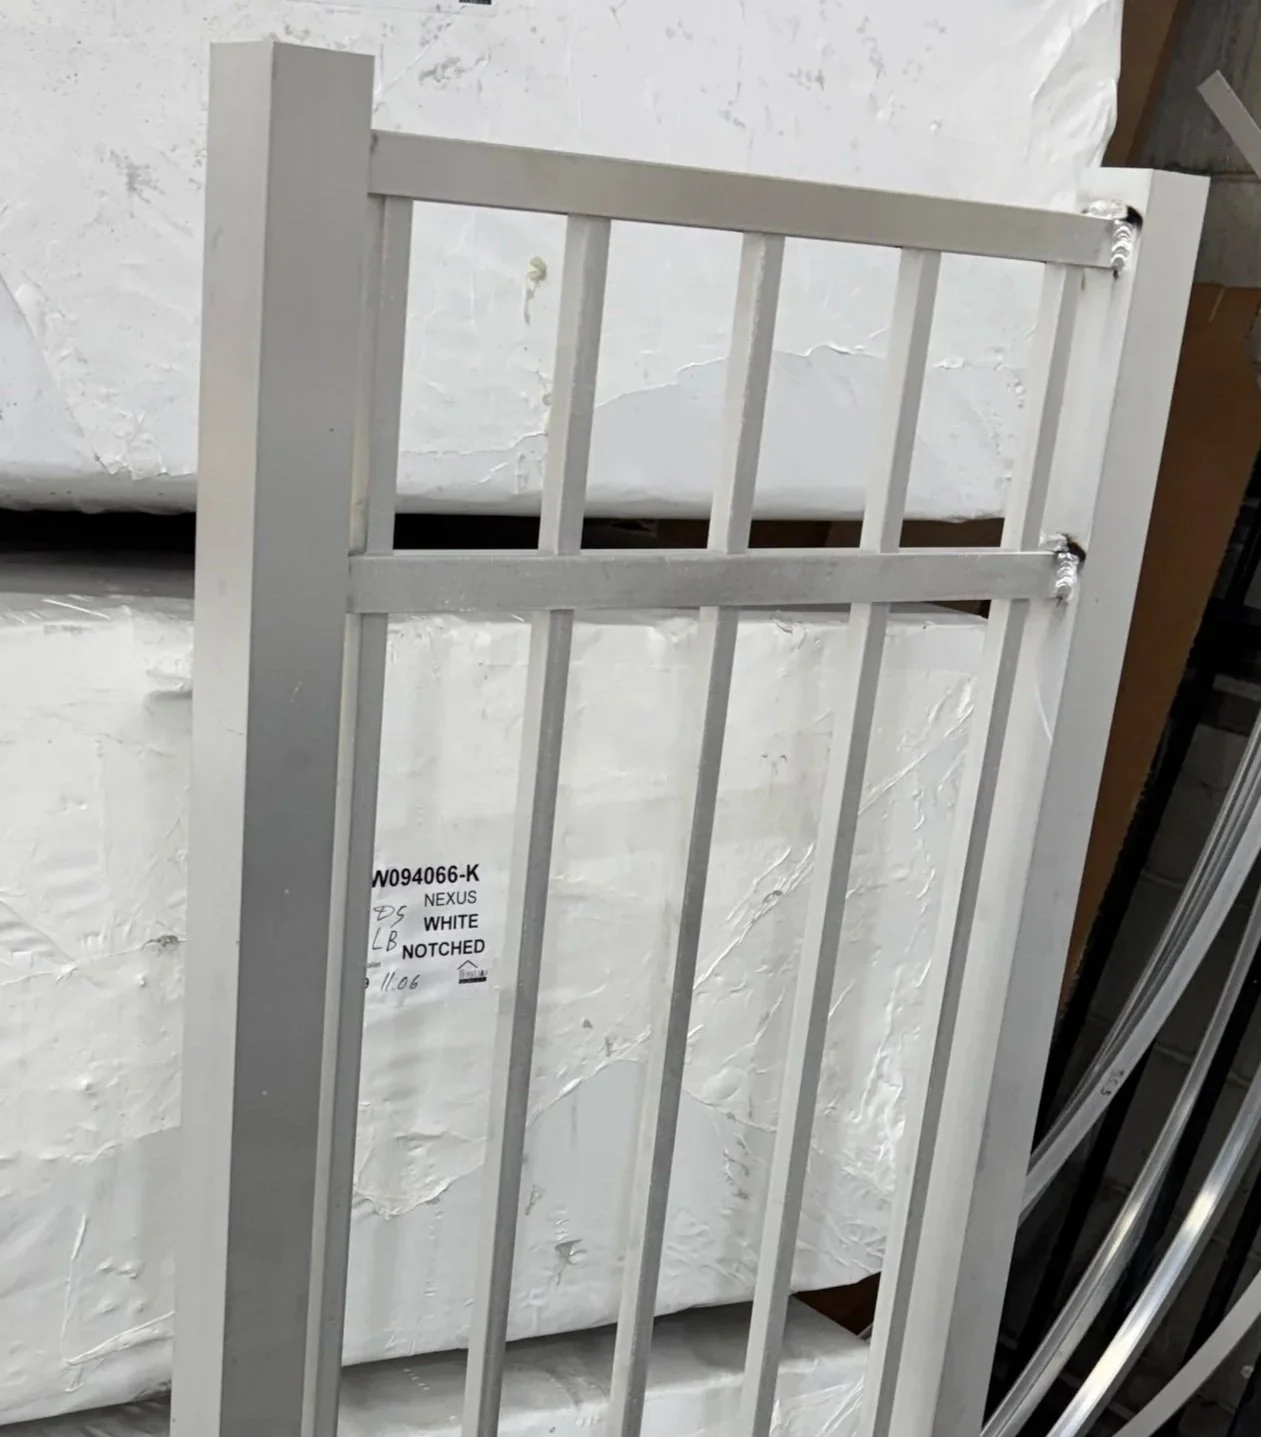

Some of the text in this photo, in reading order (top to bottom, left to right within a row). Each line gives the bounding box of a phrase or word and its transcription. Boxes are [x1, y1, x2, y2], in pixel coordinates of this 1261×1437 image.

[424, 890, 477, 907] NEXUS
[424, 914, 478, 931] WHITE
[402, 939, 485, 959] NOTCHED
